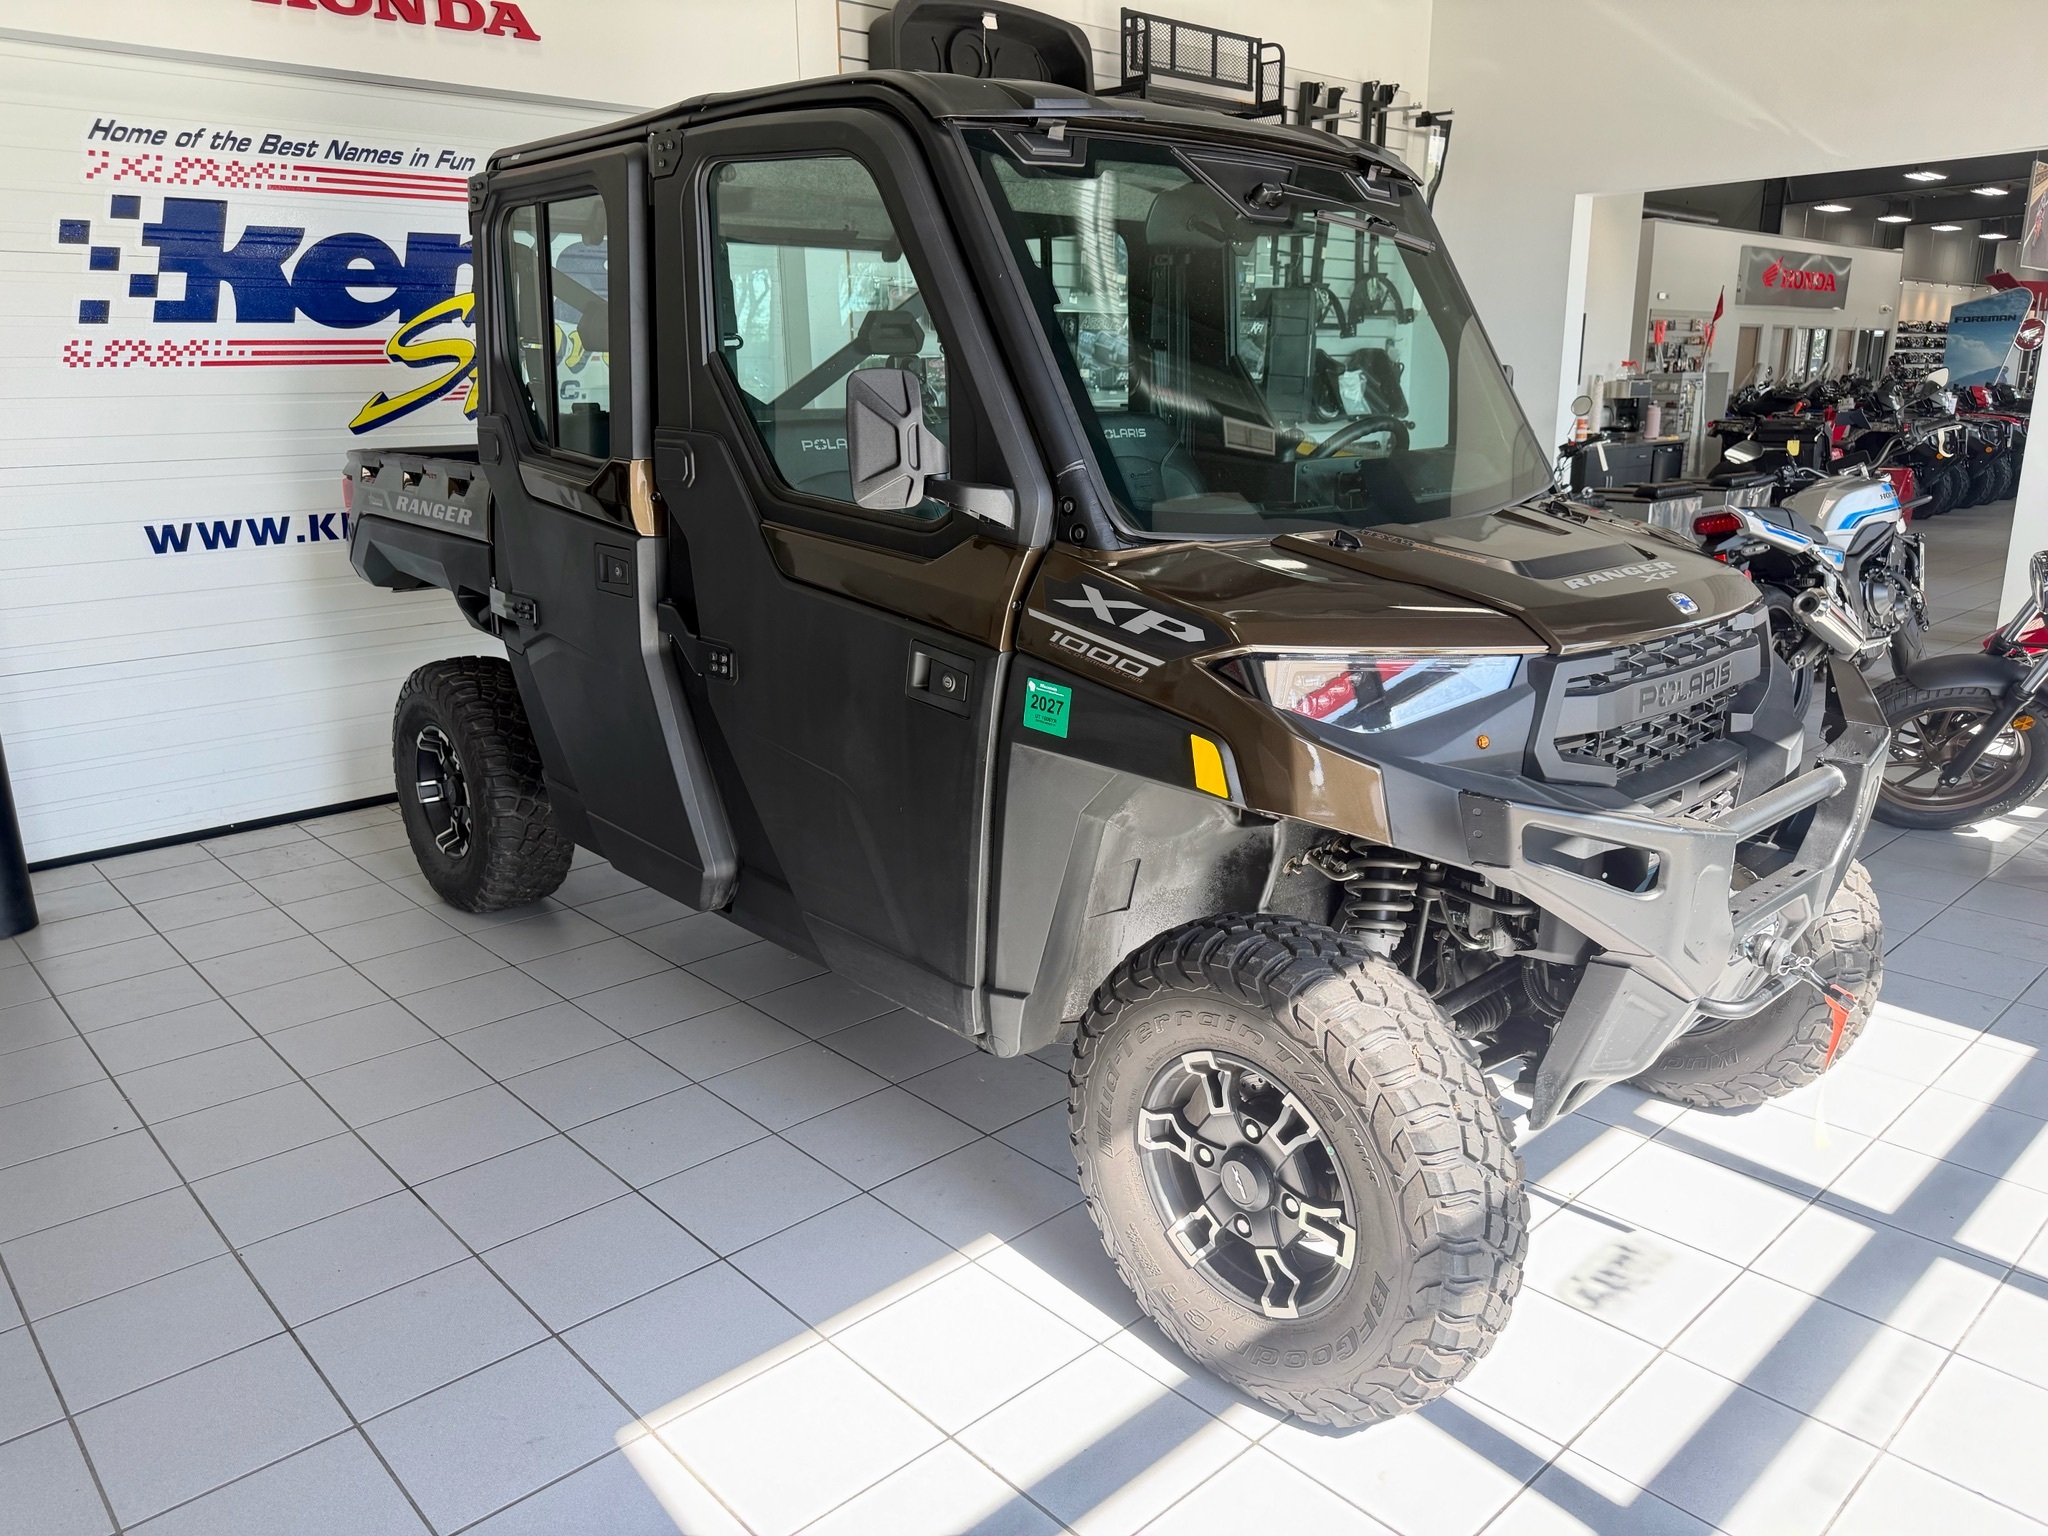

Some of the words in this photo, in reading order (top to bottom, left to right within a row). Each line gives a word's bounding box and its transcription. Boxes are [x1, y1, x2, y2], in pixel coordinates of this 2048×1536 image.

[255, 0, 541, 41] NDA
[87, 118, 167, 146] Home
[174, 128, 206, 148] of
[210, 130, 252, 153] the
[258, 133, 318, 159] Best
[323, 139, 403, 165] Names
[409, 147, 432, 168] in
[435, 149, 477, 172] Fun
[1780, 269, 1836, 292] HONDA
[1954, 314, 2017, 324] FOREMAN
[395, 495, 473, 526] RANGER
[1563, 561, 1677, 590] RANGER
[1638, 570, 1679, 583] XP
[1052, 583, 1206, 643] XP
[1049, 630, 1149, 678] 1000
[1049, 642, 1072, 654] DUAL
[1074, 652, 1121, 675] OVERHEAD
[1638, 659, 1732, 714] POLARIS
[1030, 693, 1064, 716] 2027
[1161, 1271, 1391, 1369] BFGoodrich
